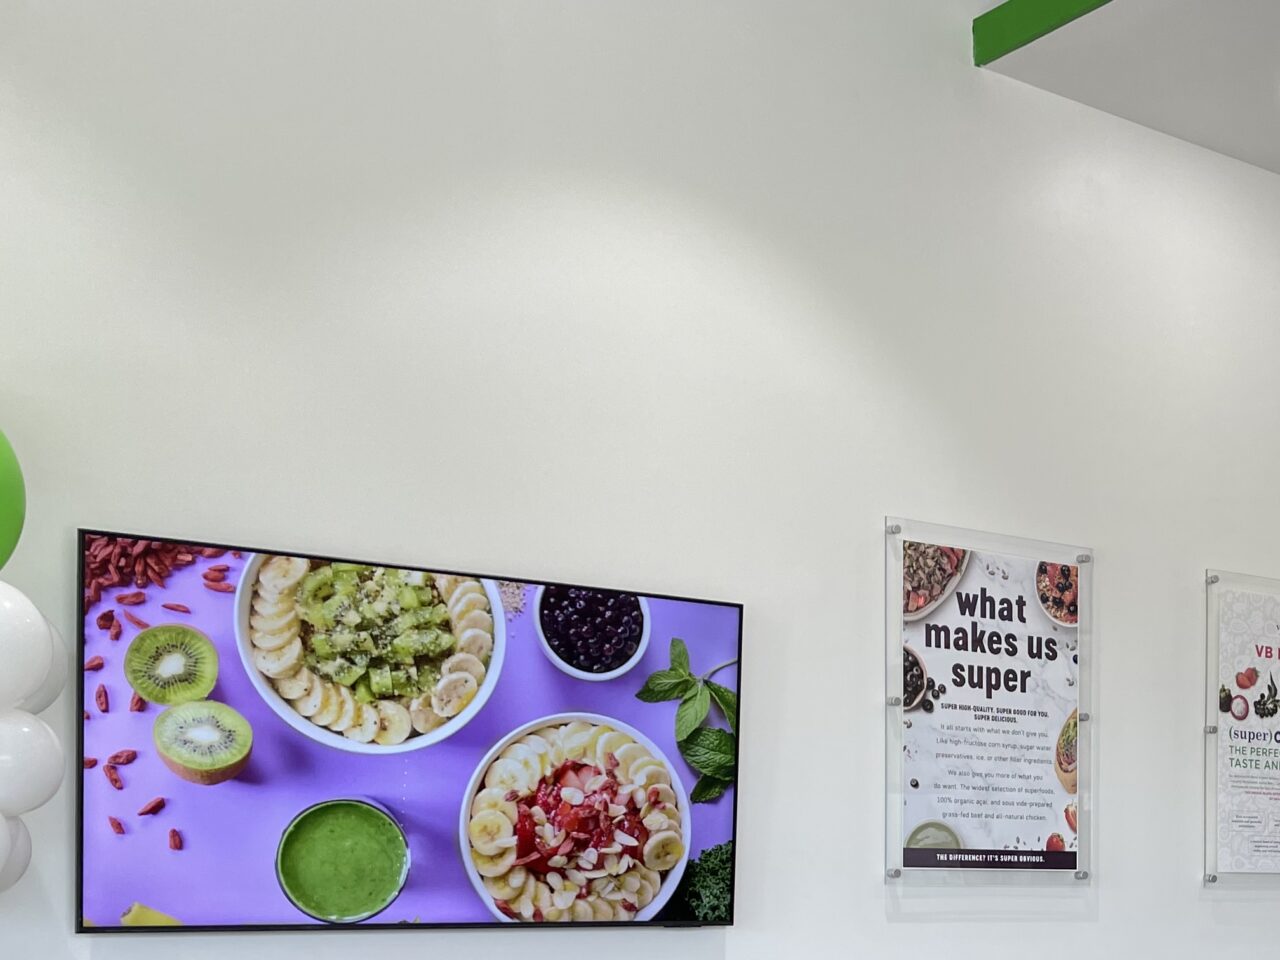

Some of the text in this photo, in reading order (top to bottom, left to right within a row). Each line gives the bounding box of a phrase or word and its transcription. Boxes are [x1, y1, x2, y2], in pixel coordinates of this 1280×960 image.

[956, 587, 1026, 623] what
[925, 621, 1058, 661] makes us
[1255, 644, 1273, 659] VB
[952, 663, 1031, 699] super
[1229, 745, 1247, 756] THE
[1229, 758, 1260, 770] TASTE
[937, 796, 953, 804] 100%
[954, 798, 975, 806] organic
[949, 854, 986, 862] DIFFERENCE?
[988, 854, 999, 862] IT'S
